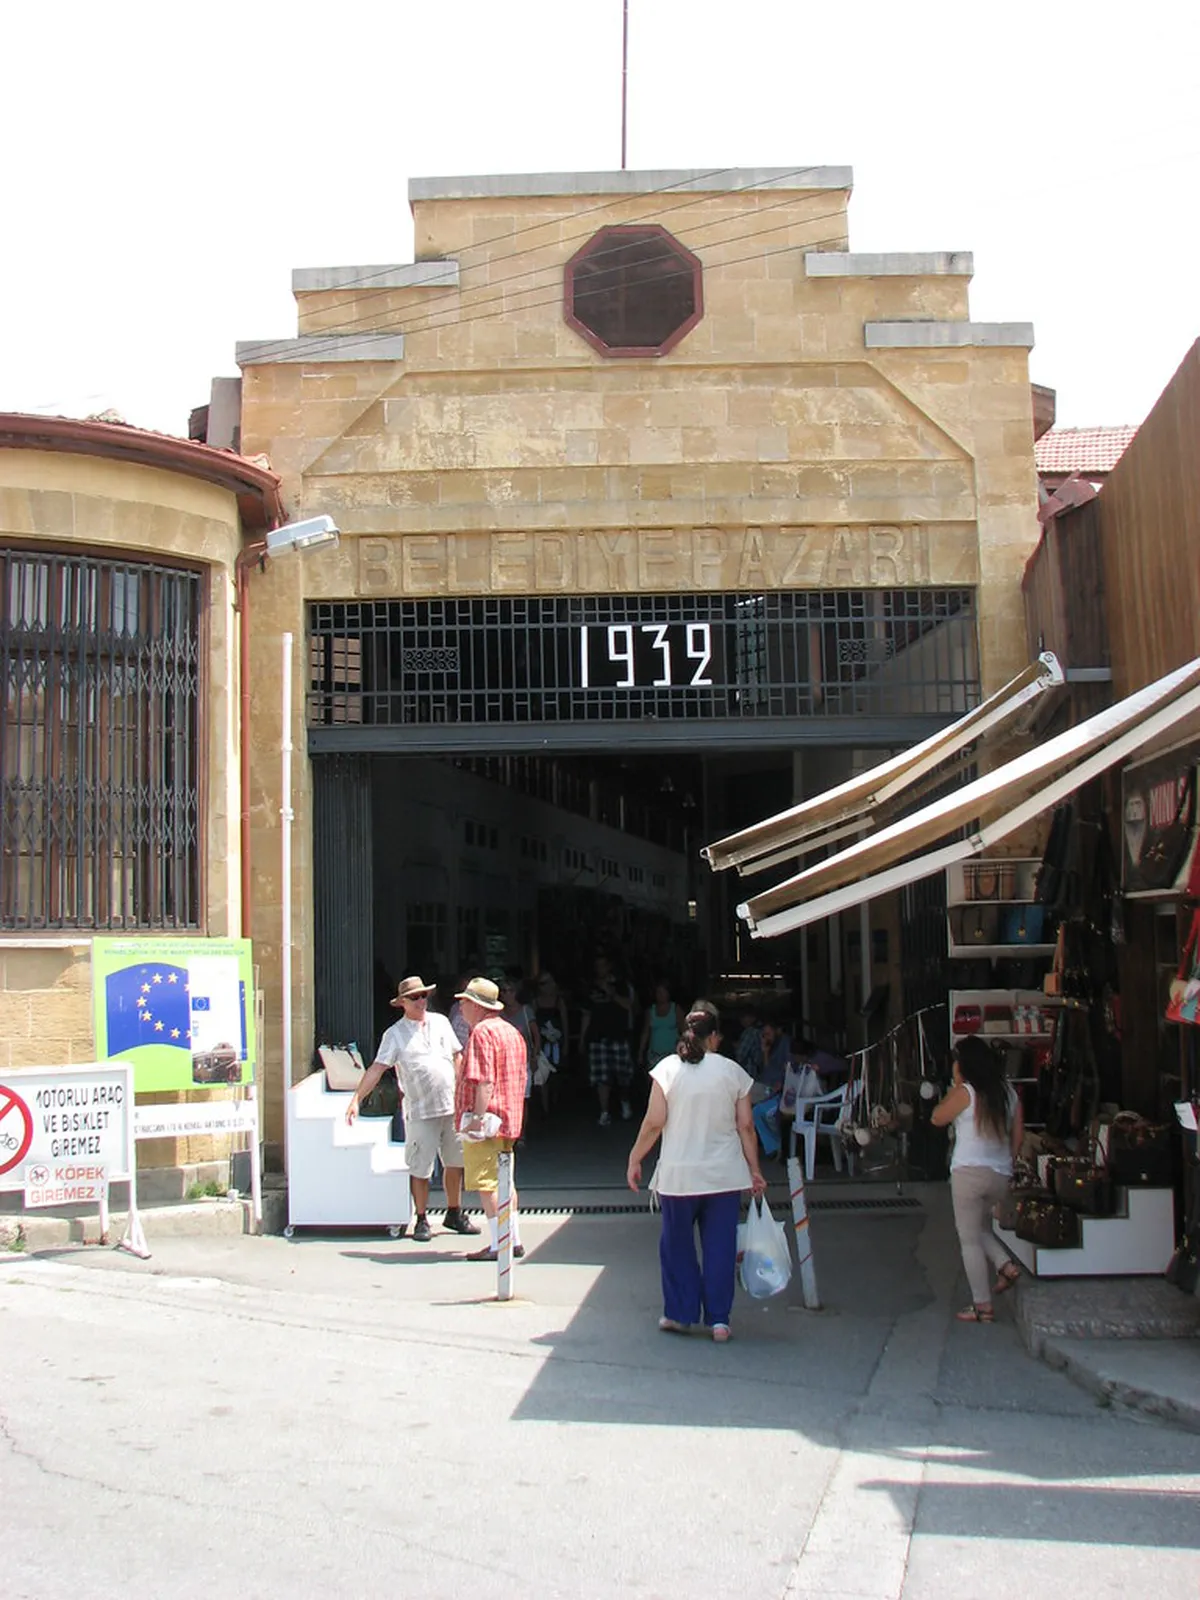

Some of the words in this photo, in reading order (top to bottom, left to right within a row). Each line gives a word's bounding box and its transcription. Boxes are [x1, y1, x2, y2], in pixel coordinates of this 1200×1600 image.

[692, 523, 922, 587] PAZARI
[581, 623, 712, 688] 1932
[92, 1085, 123, 1109] ARAÇ
[43, 1114, 57, 1133] VE
[55, 1164, 104, 1180] KÖPEK
